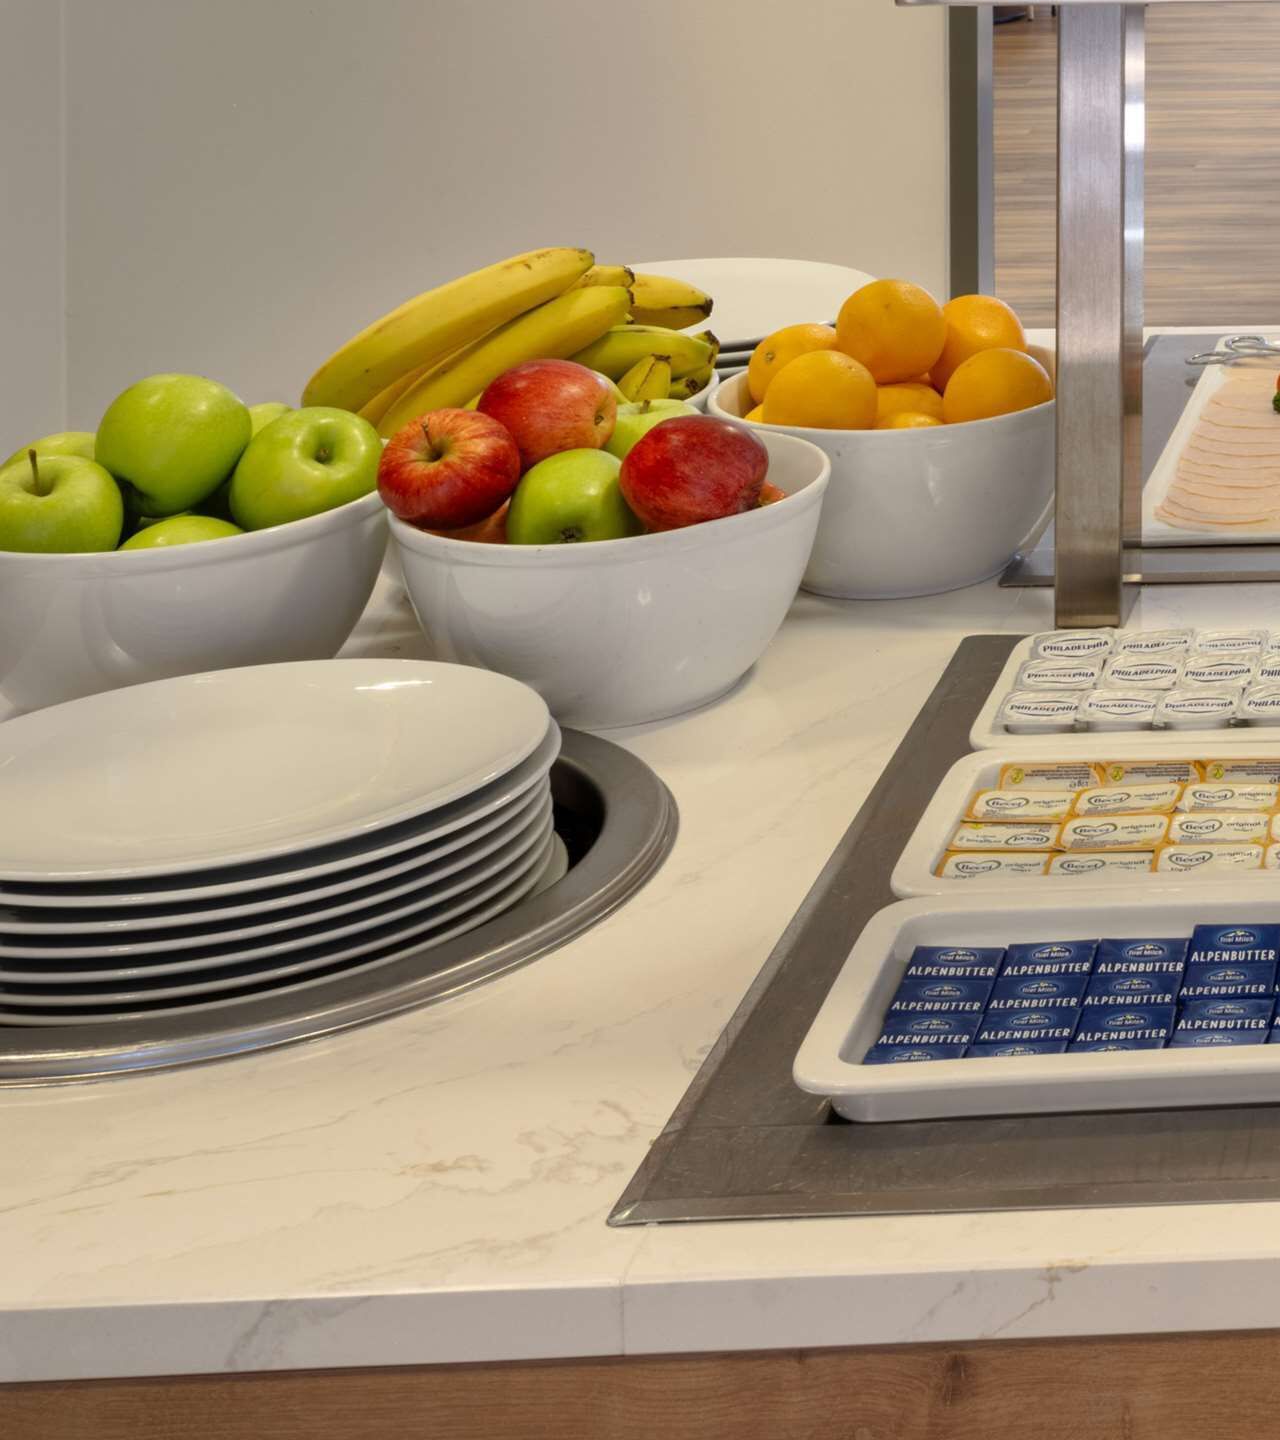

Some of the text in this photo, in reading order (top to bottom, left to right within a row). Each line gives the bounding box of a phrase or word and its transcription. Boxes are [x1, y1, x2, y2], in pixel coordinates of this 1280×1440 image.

[1043, 640, 1109, 652] PHILADELPHIA
[1122, 639, 1188, 650] PHILADELPHIA
[1027, 671, 1095, 679] PHILADELPHIA
[1111, 668, 1177, 677] PHILADELPHIA
[1185, 667, 1251, 678] PHILADELPHIA
[1010, 704, 1079, 712] PHILADELPHIA
[1088, 702, 1157, 710] PHILADELPHIA
[1165, 700, 1234, 709] PHILADELPHIA
[1191, 949, 1276, 962] ALPENBUTTER
[908, 966, 995, 976] ALPENBUTTER
[1003, 962, 1090, 976] ALPENBUTTER
[1098, 962, 1184, 973] ALPENBUTTER
[1180, 984, 1266, 996] ALPENBUTTER
[989, 997, 1078, 1009] ALPENBUTTER
[1084, 994, 1172, 1005] ALPENBUTTER
[892, 1001, 981, 1011] ALPENBUTTER
[1177, 1019, 1266, 1030] ALPENBUTTER
[878, 1034, 970, 1045] ALPENBUTTER
[980, 1028, 1071, 1040] ALPENBUTTER
[1077, 1029, 1167, 1041] ALPENBUTTER
